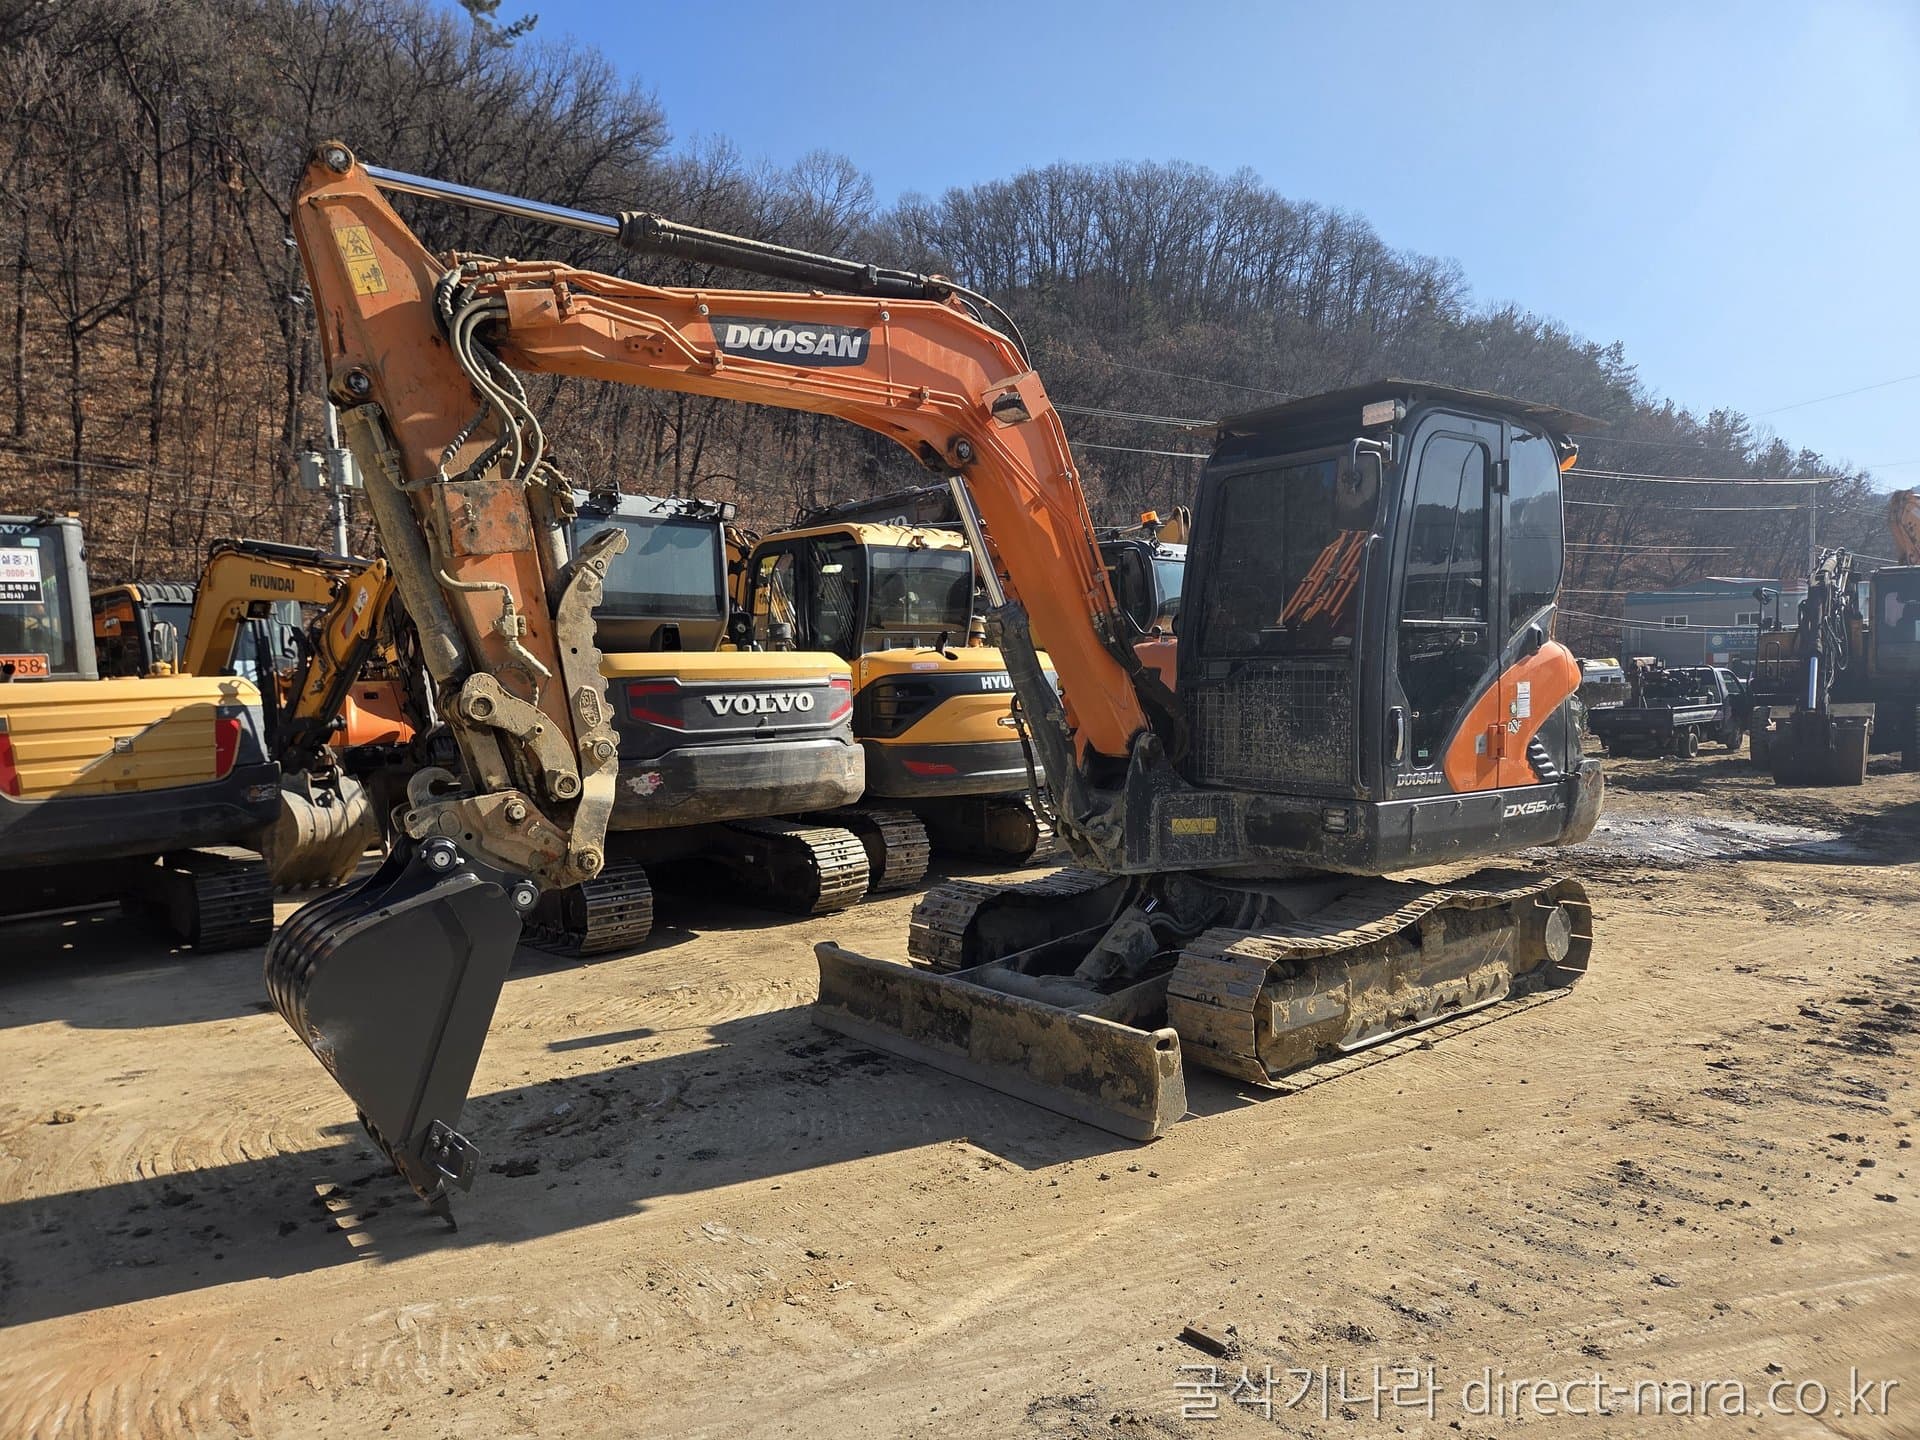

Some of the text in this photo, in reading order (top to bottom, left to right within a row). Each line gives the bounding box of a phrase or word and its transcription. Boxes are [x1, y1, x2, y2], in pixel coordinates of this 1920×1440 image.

[725, 324, 861, 358] DOOSAN
[0, 524, 31, 534] VO
[250, 574, 295, 592] HYUNDAI
[981, 675, 1014, 690] HYU
[705, 692, 815, 716] VOLVO
[1397, 771, 1443, 787] DOOSAN
